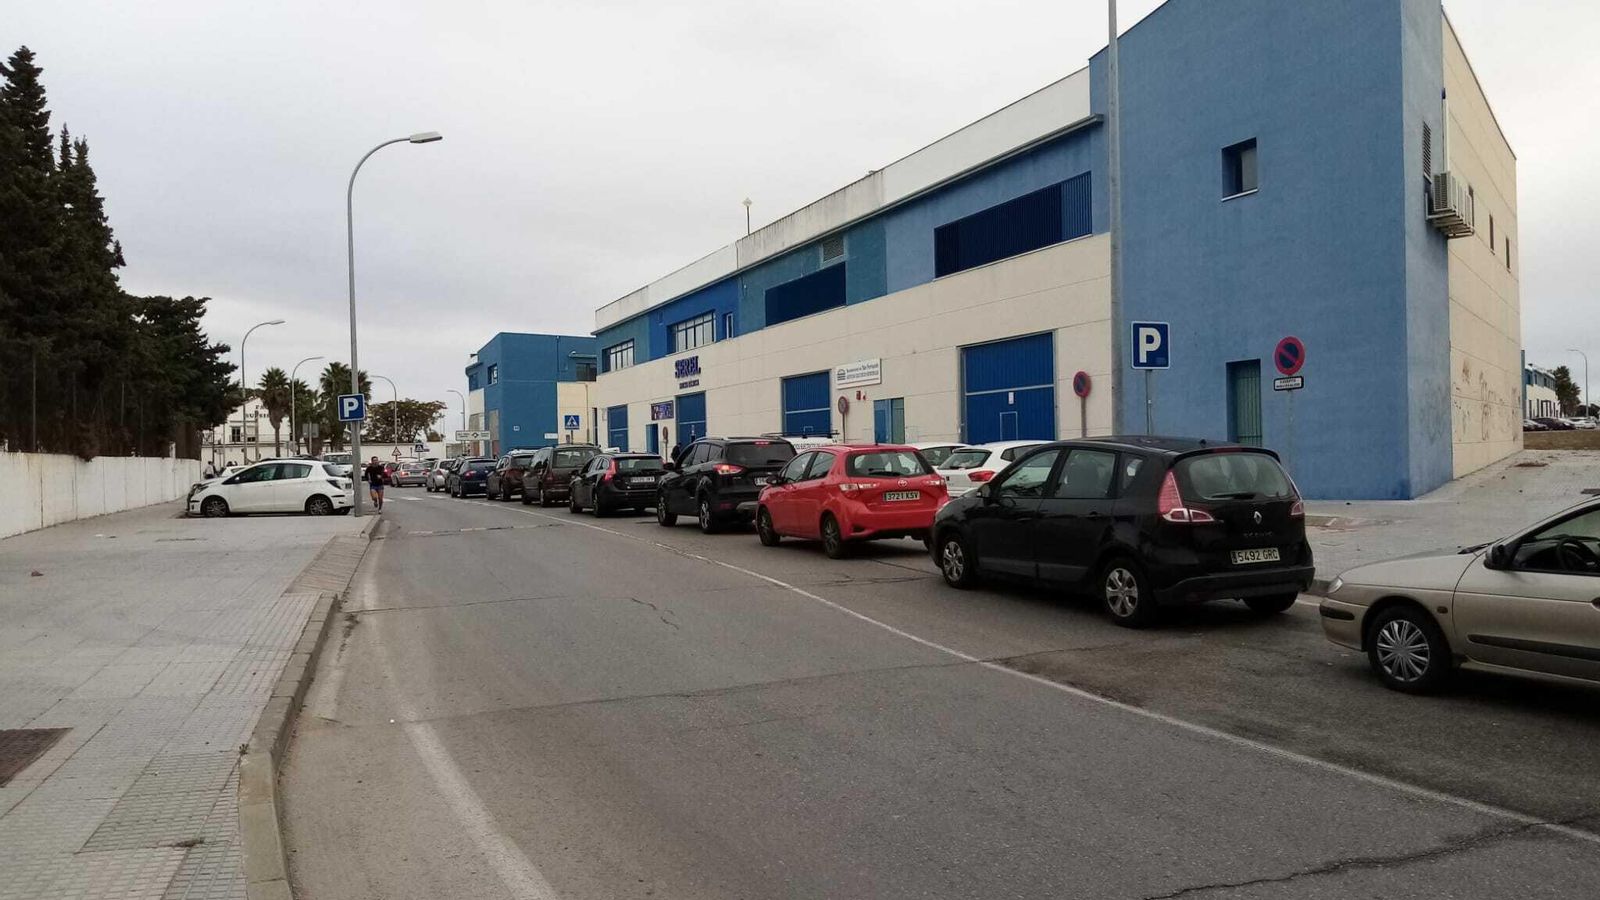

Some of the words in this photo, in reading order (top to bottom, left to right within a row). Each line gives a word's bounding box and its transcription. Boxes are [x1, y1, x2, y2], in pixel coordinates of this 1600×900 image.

[1139, 327, 1161, 363] P
[343, 397, 359, 418] P
[887, 492, 904, 500] 3721
[1237, 550, 1261, 562] 5492
[1262, 549, 1279, 560] GRC
